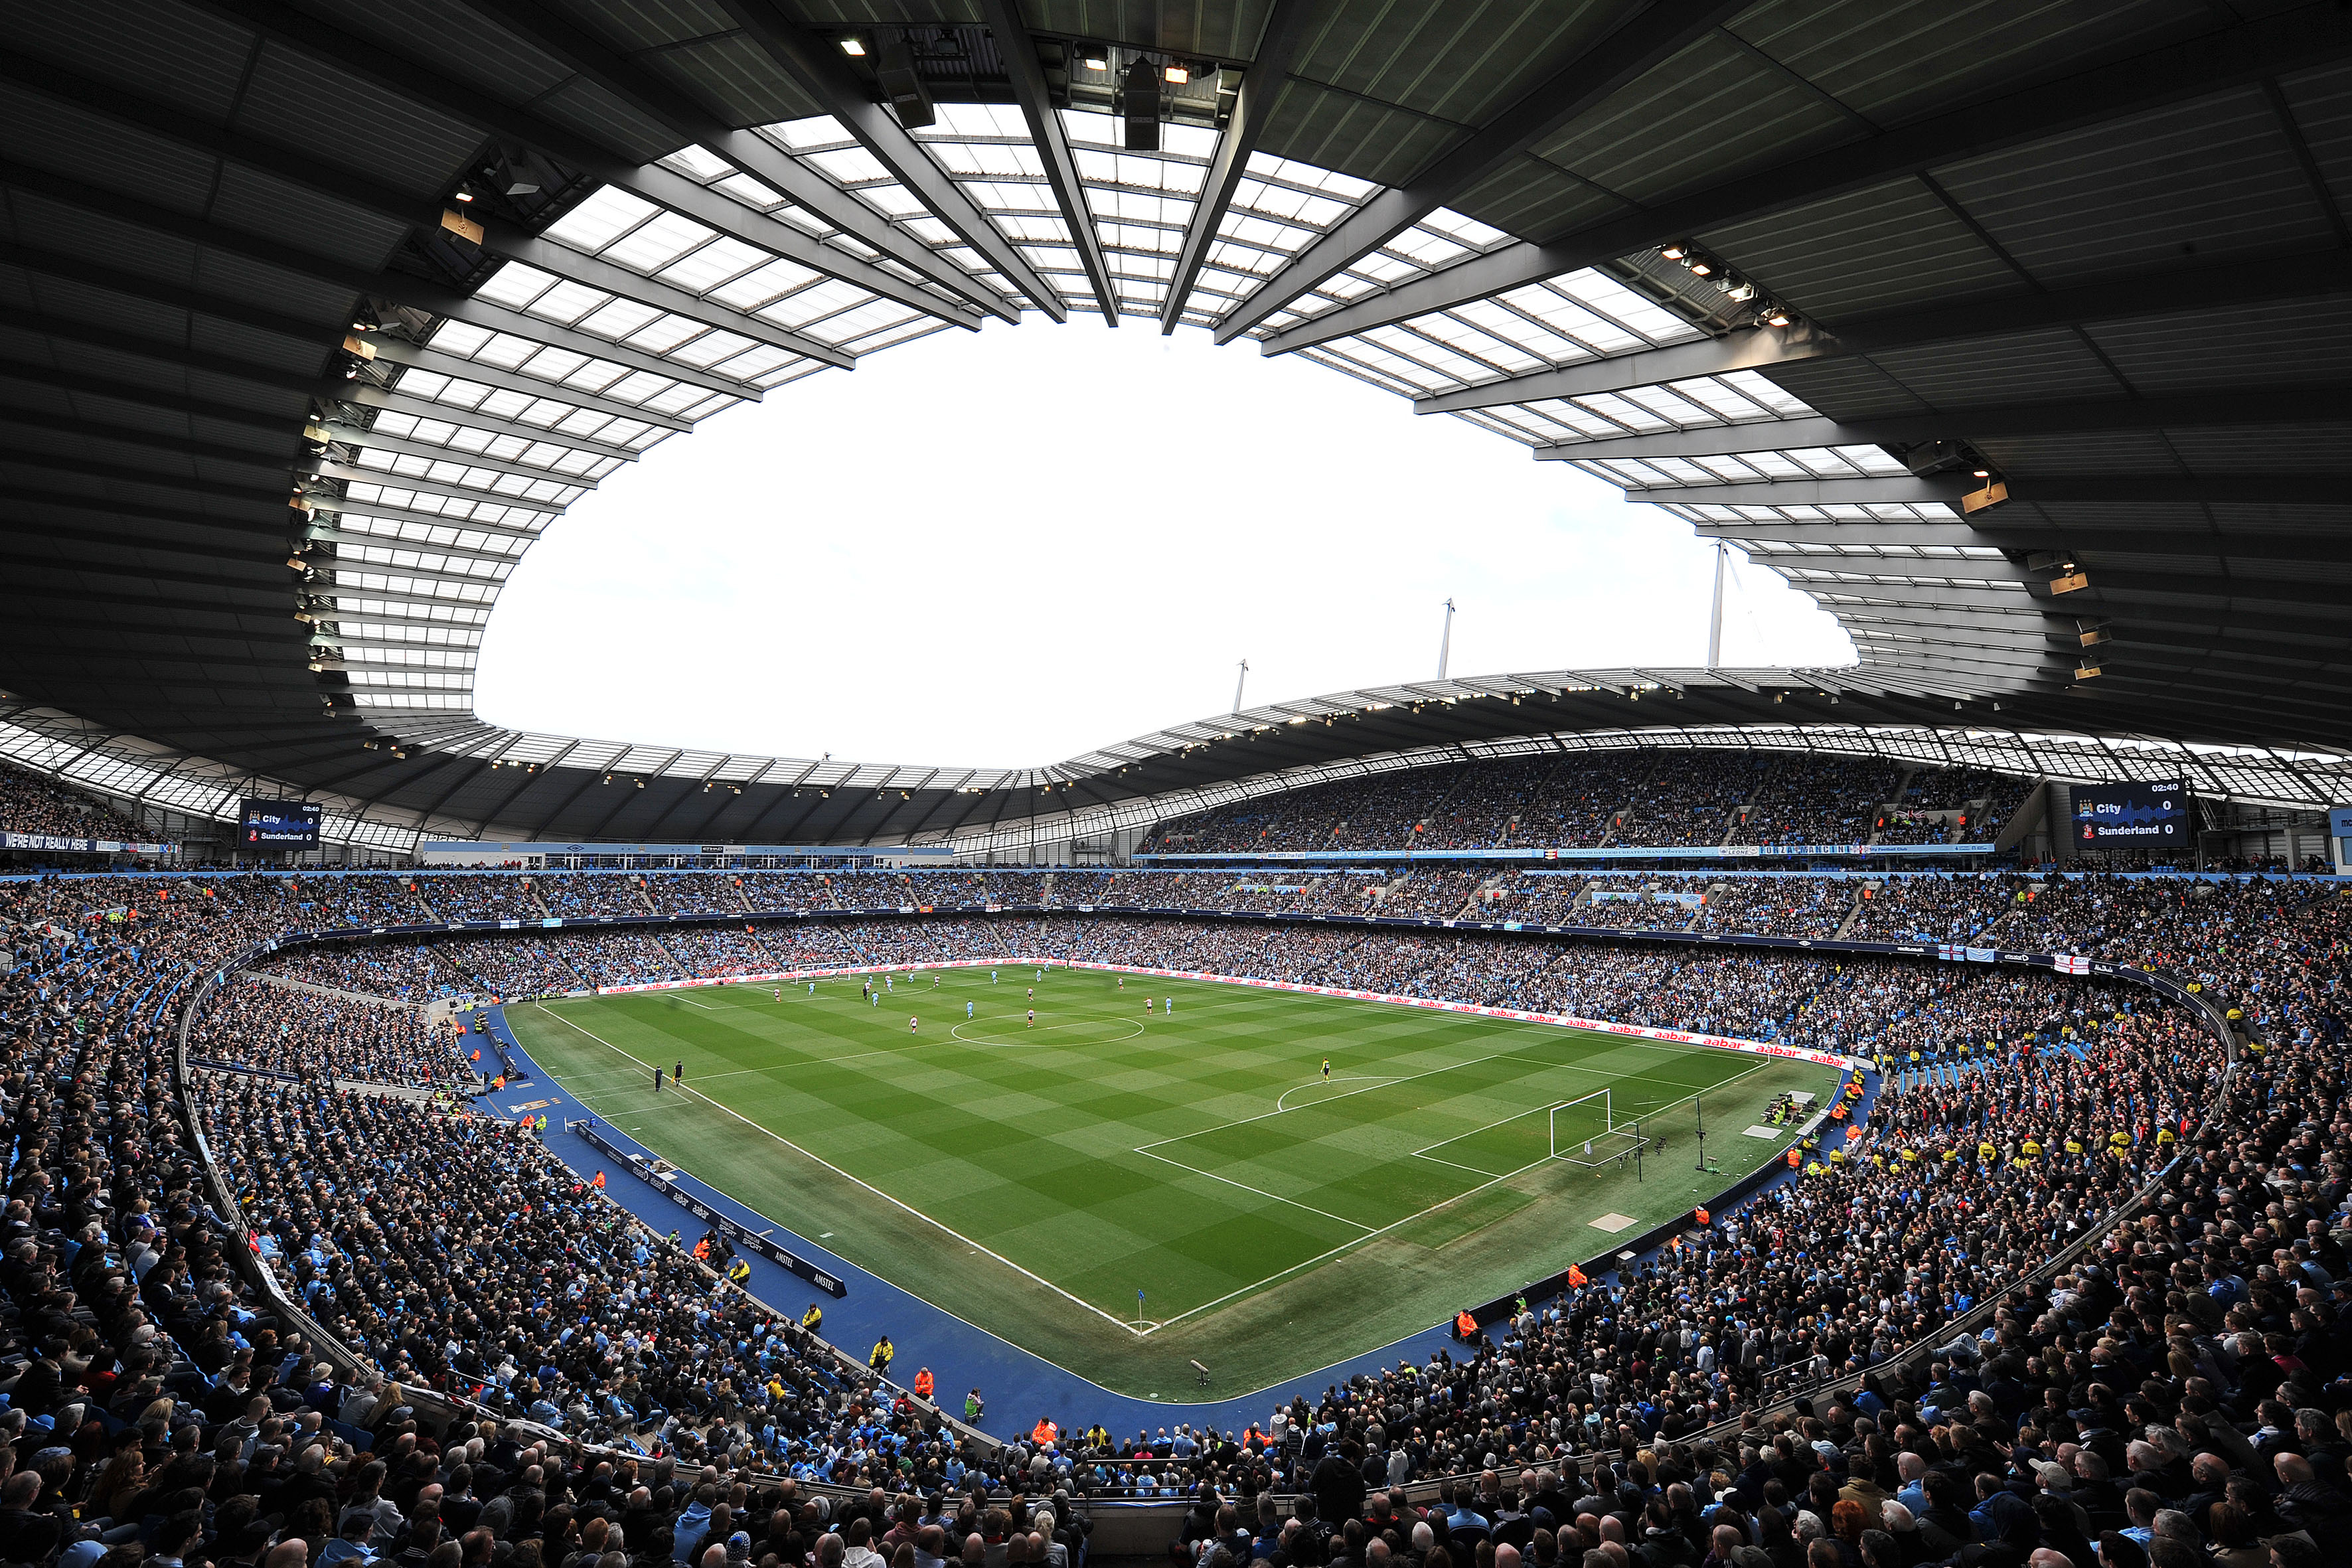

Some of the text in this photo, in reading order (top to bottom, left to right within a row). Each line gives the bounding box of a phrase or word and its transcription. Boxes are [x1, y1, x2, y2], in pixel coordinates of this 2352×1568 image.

[2152, 783, 2179, 792] 02:40
[2096, 800, 2171, 815] City 0
[262, 815, 281, 824] City
[2098, 824, 2173, 836] Sunderland 0
[29, 835, 44, 849] NOT
[44, 836, 70, 850] REALLY
[70, 838, 88, 850] HERE
[1419, 1000, 1445, 1008] aabar
[1452, 1004, 1482, 1013] aabar
[1488, 1008, 1518, 1018] aabar
[1526, 1013, 1558, 1023] aabar
[1567, 1018, 1601, 1028] aabar
[1609, 1024, 1645, 1035] aabar
[1654, 1030, 1693, 1042] aabar
[1703, 1037, 1745, 1050] aabar
[1756, 1046, 1802, 1058] aabar
[1811, 1054, 1846, 1067] aabar
[673, 1192, 709, 1219] aabar aabar
[718, 1225, 737, 1238] SPORT
[742, 1238, 763, 1252] SPORT
[775, 1251, 794, 1268] AMSTEL
[813, 1273, 835, 1291] AMSTEL
